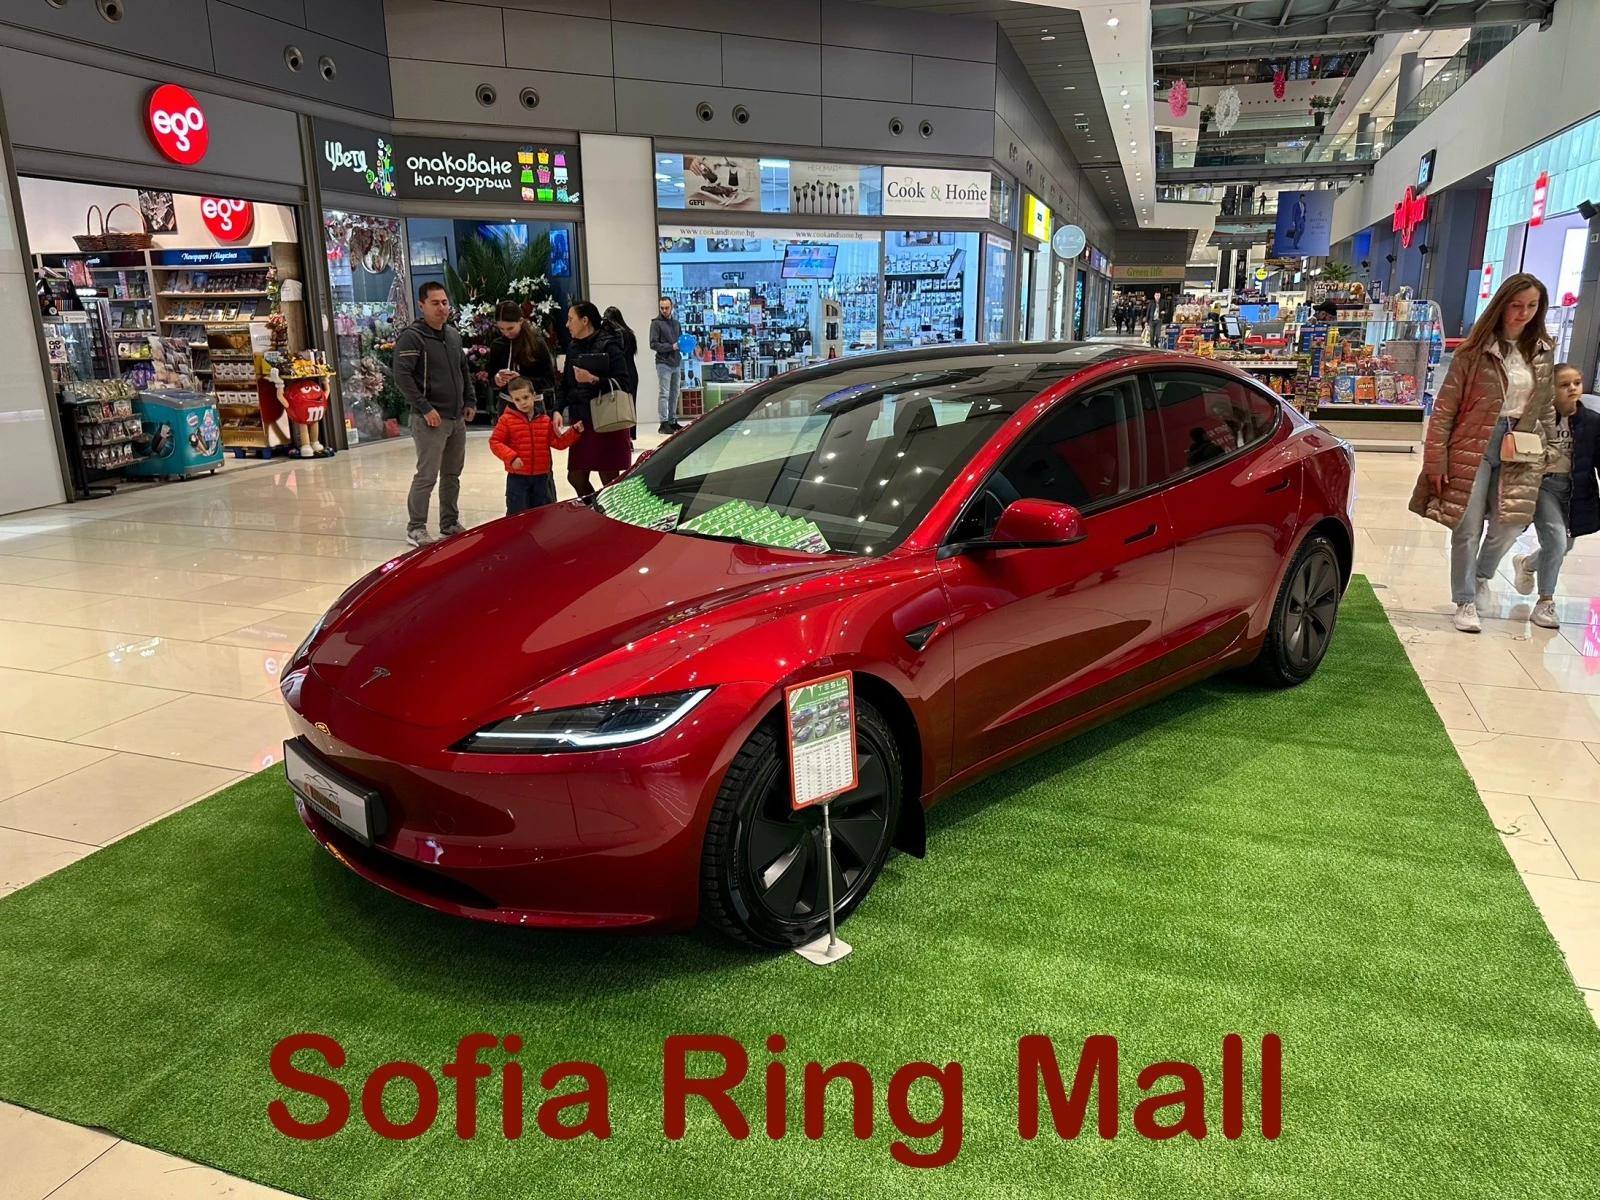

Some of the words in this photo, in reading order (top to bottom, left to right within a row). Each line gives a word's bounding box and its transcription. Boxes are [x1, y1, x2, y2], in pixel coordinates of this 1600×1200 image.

[153, 106, 204, 152] ego
[406, 151, 512, 174] опаковане
[414, 171, 434, 187] на
[436, 173, 512, 194] подаръци
[887, 180, 925, 199] Cook
[930, 185, 942, 201] &
[945, 183, 988, 201] Home
[688, 198, 705, 206] GEFU
[203, 198, 246, 231] ego
[679, 227, 755, 238] www.cookandhome.bg
[795, 230, 863, 240] www.cookandhome.bg
[1126, 266, 1149, 277] Green
[817, 677, 848, 692] TESLA
